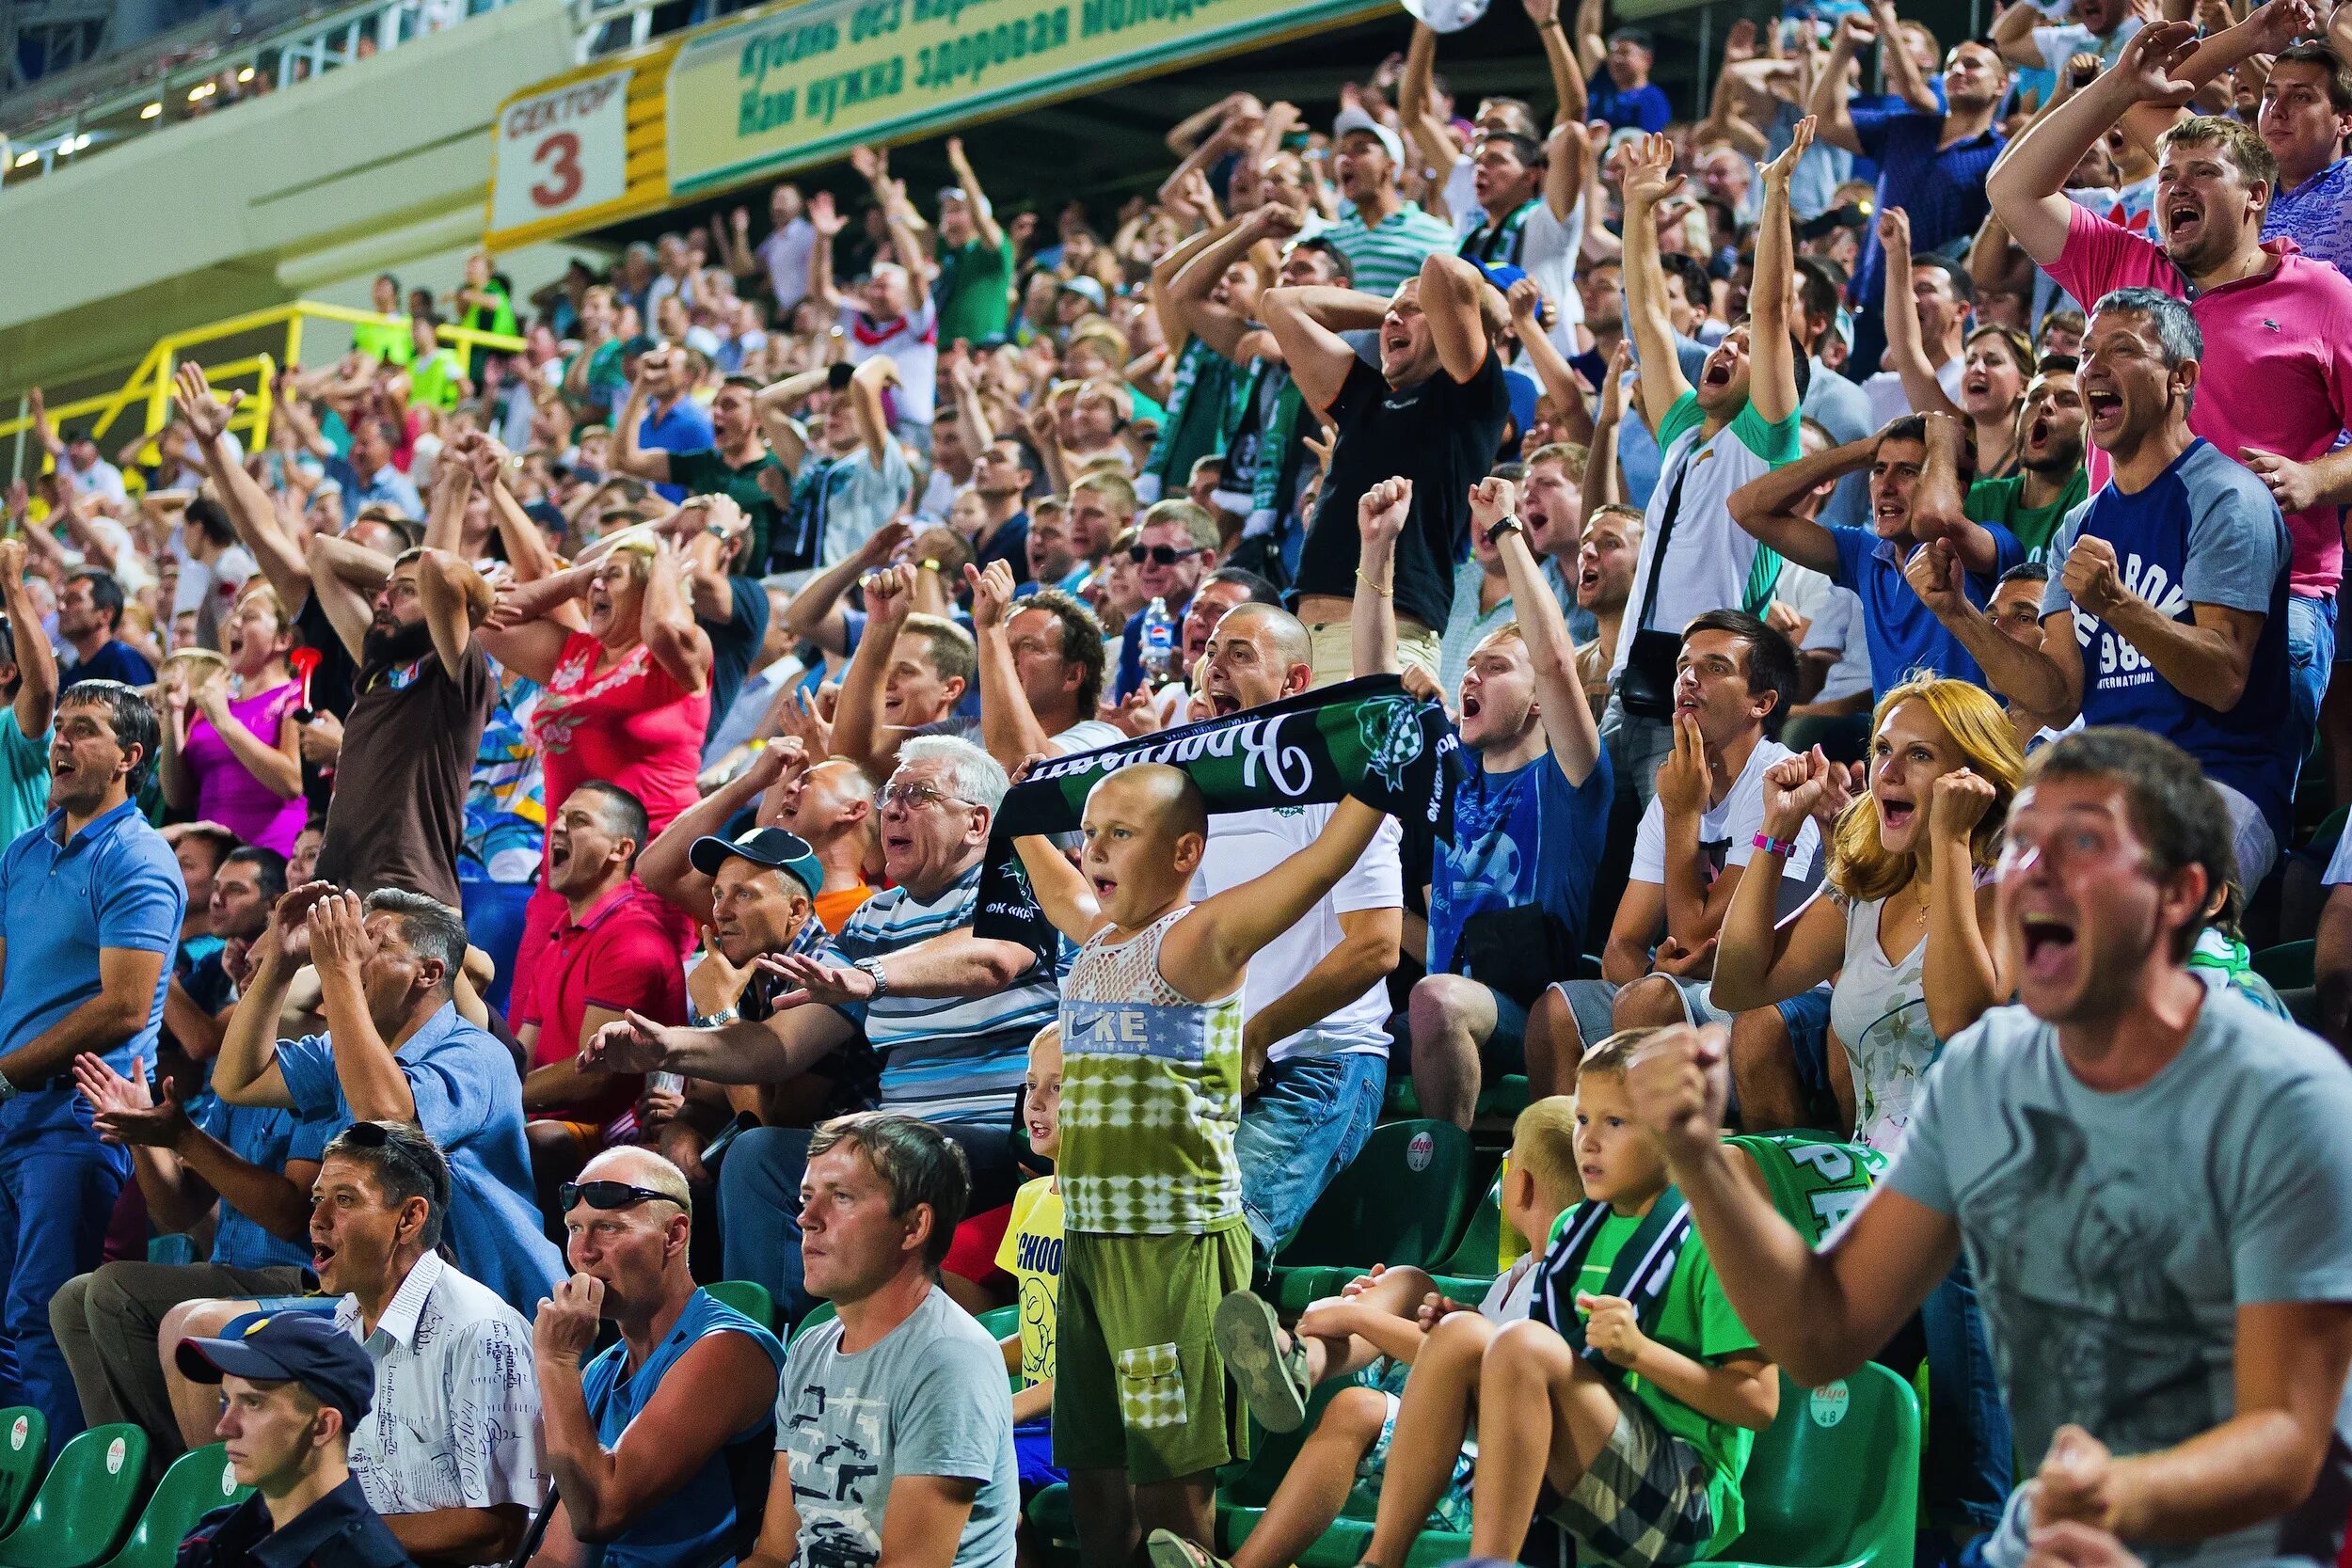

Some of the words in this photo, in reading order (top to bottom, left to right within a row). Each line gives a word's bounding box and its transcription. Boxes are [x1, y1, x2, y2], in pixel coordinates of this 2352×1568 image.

[508, 75, 620, 141] СЕКТОР
[531, 131, 584, 208] 3
[985, 902, 1008, 914] ФК
